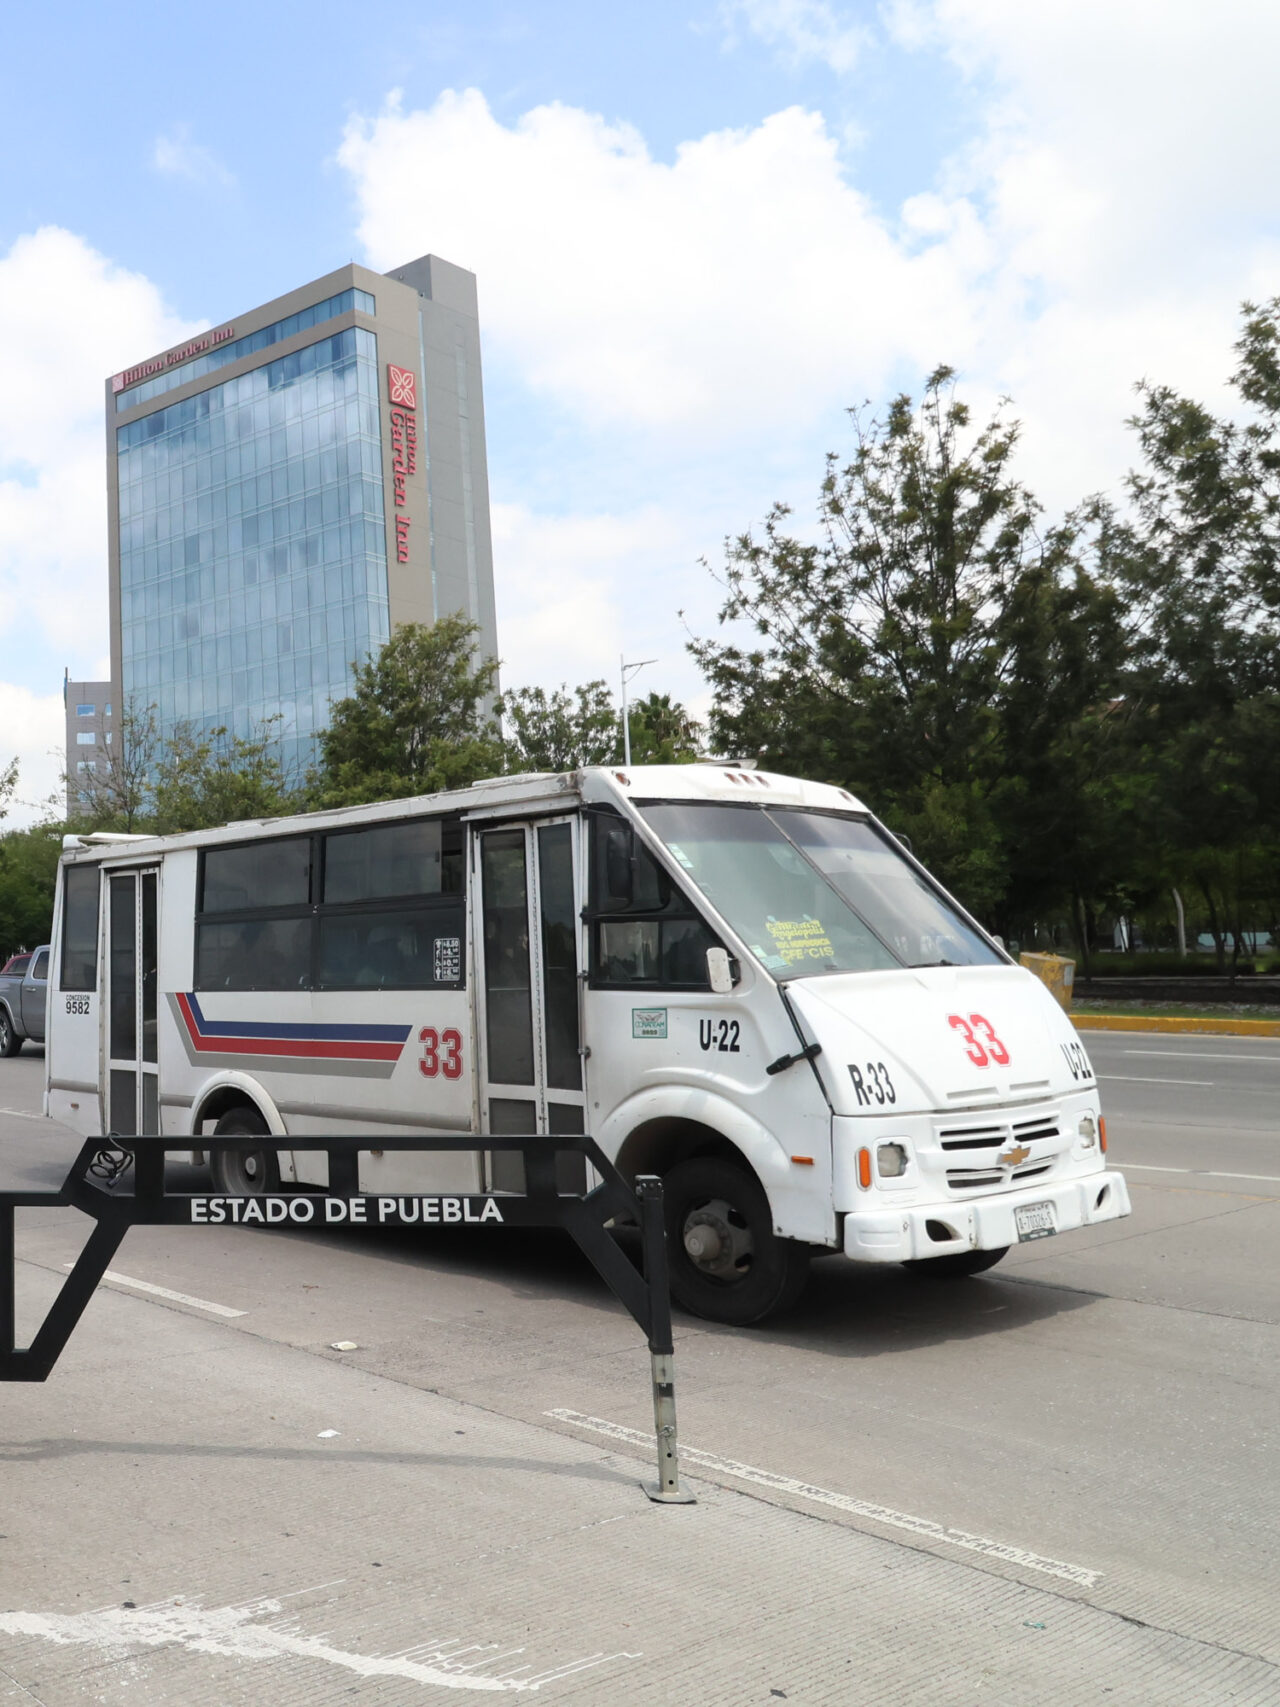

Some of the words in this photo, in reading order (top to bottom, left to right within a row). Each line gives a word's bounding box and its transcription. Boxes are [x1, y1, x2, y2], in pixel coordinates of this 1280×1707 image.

[124, 359, 163, 386] Hilton
[164, 339, 210, 367] Garden
[211, 327, 234, 346] Inn
[390, 407, 409, 507] Garden
[404, 413, 417, 475] Hilton
[395, 513, 411, 564] Inn
[66, 1001, 90, 1015] 9582
[418, 1026, 464, 1081] 33
[699, 1018, 740, 1053] U-22
[946, 1012, 1013, 1070] 33
[847, 1061, 897, 1106] R-33
[1060, 1042, 1093, 1081] U-22
[190, 1197, 314, 1223] ESTADO
[324, 1197, 368, 1223] DE
[378, 1197, 504, 1223] PUEBLA
